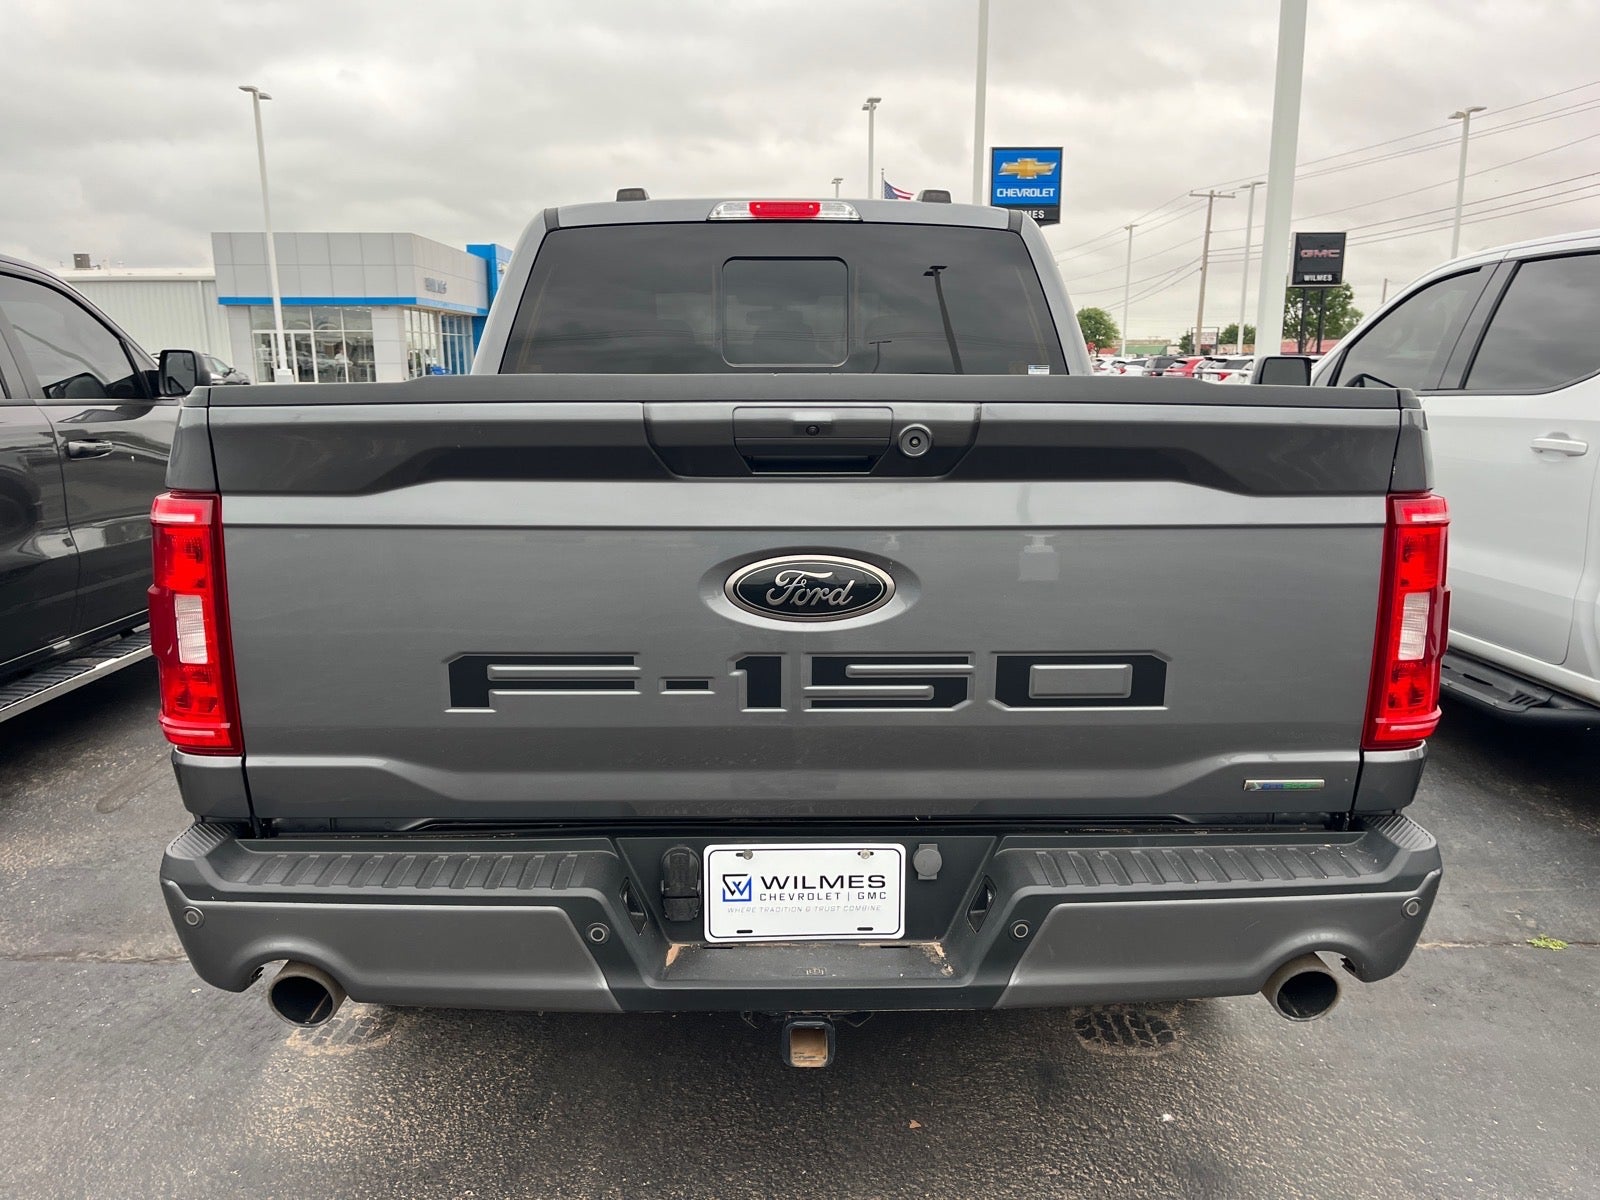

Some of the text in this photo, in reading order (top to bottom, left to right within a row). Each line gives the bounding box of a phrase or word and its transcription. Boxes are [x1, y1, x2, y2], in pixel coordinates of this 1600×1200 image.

[996, 188, 1055, 198] CHEVROLET
[1300, 249, 1340, 258] GMC
[1303, 274, 1333, 282] WILMES
[765, 569, 856, 606] Ford
[445, 652, 1169, 712] F-150
[760, 874, 887, 890] WILMES
[759, 891, 887, 902] CHEVROLET GMC
[843, 904, 882, 912] COMBINE
